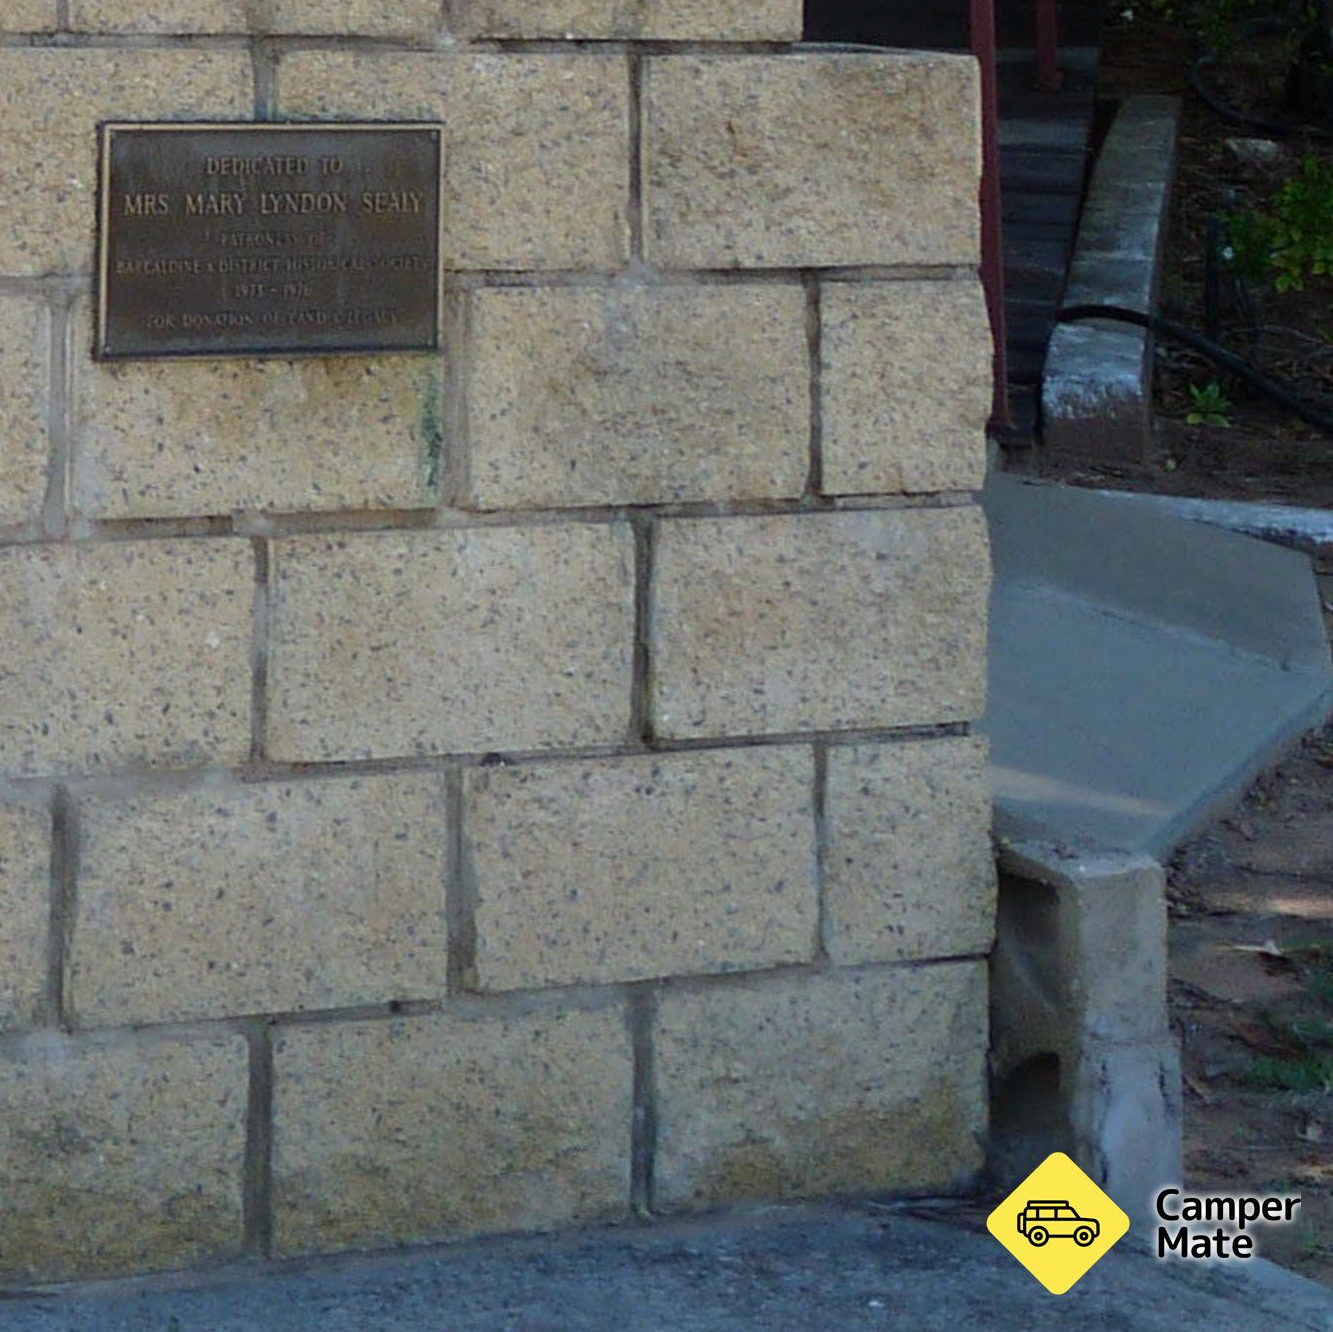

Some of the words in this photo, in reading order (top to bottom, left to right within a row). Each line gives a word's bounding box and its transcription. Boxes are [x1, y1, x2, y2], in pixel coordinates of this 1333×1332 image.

[206, 156, 308, 175] DEDICATED
[322, 156, 343, 174] TO
[123, 194, 170, 215] MRS
[185, 193, 244, 215] MARY
[260, 192, 347, 214] LYNDON
[362, 191, 424, 213] SEALY
